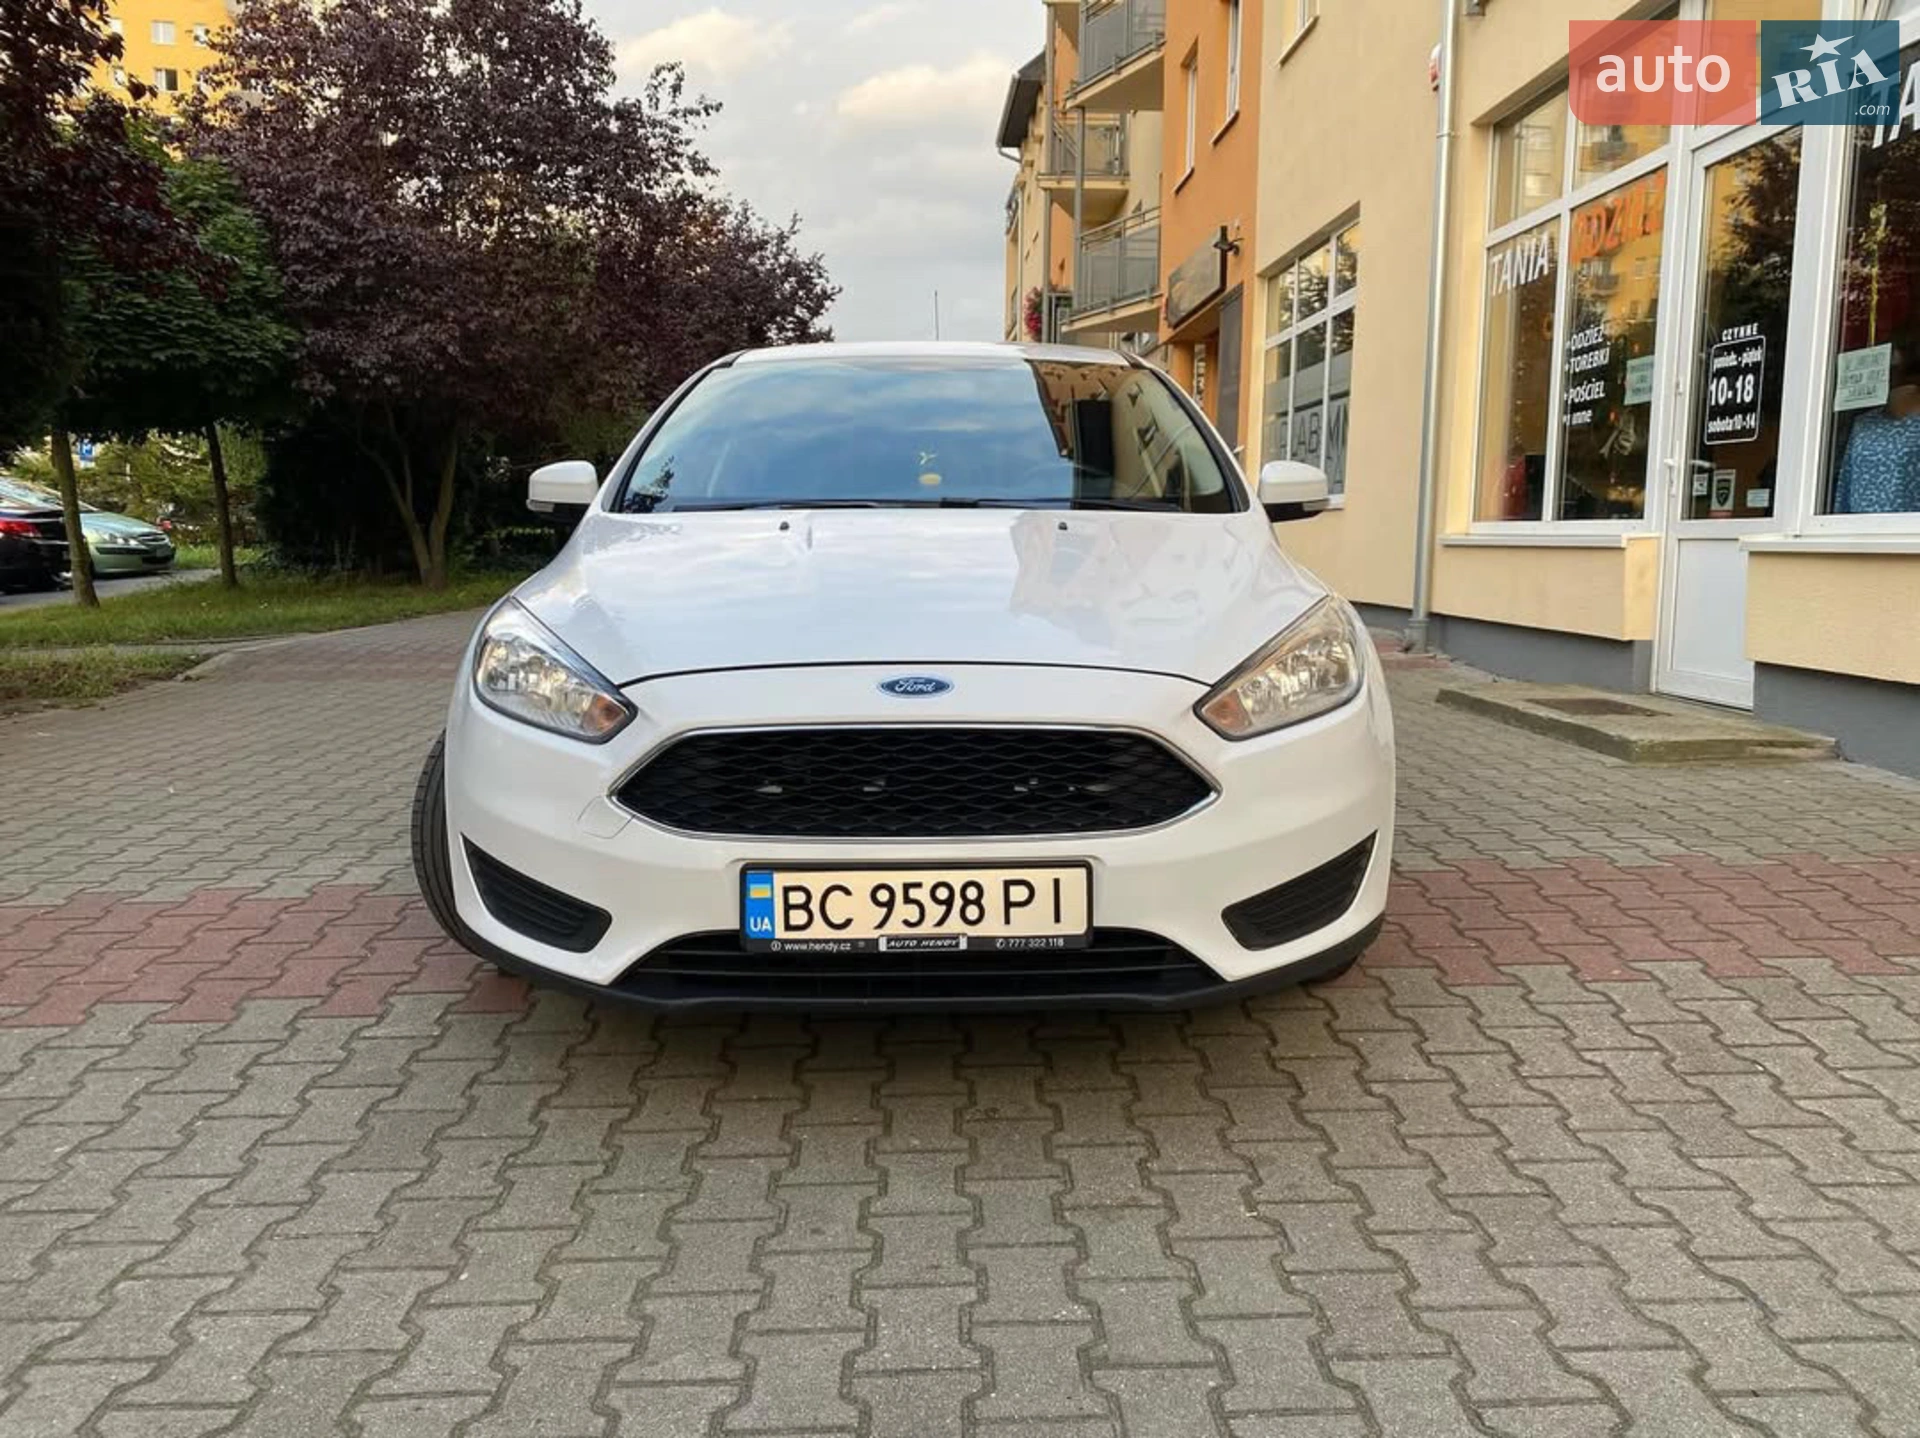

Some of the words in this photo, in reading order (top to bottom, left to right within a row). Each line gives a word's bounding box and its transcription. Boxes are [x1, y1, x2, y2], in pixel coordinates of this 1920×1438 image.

[1491, 230, 1550, 296] TANIA
[894, 678, 937, 692] Ford
[782, 884, 854, 933] BC
[870, 879, 986, 930] 9598
[1002, 877, 1061, 926] PI
[750, 917, 773, 931] UA
[784, 941, 851, 952] www.hendy.cz
[887, 939, 918, 948] AUTO
[920, 938, 959, 947] HENDY
[1008, 938, 1025, 948] 777
